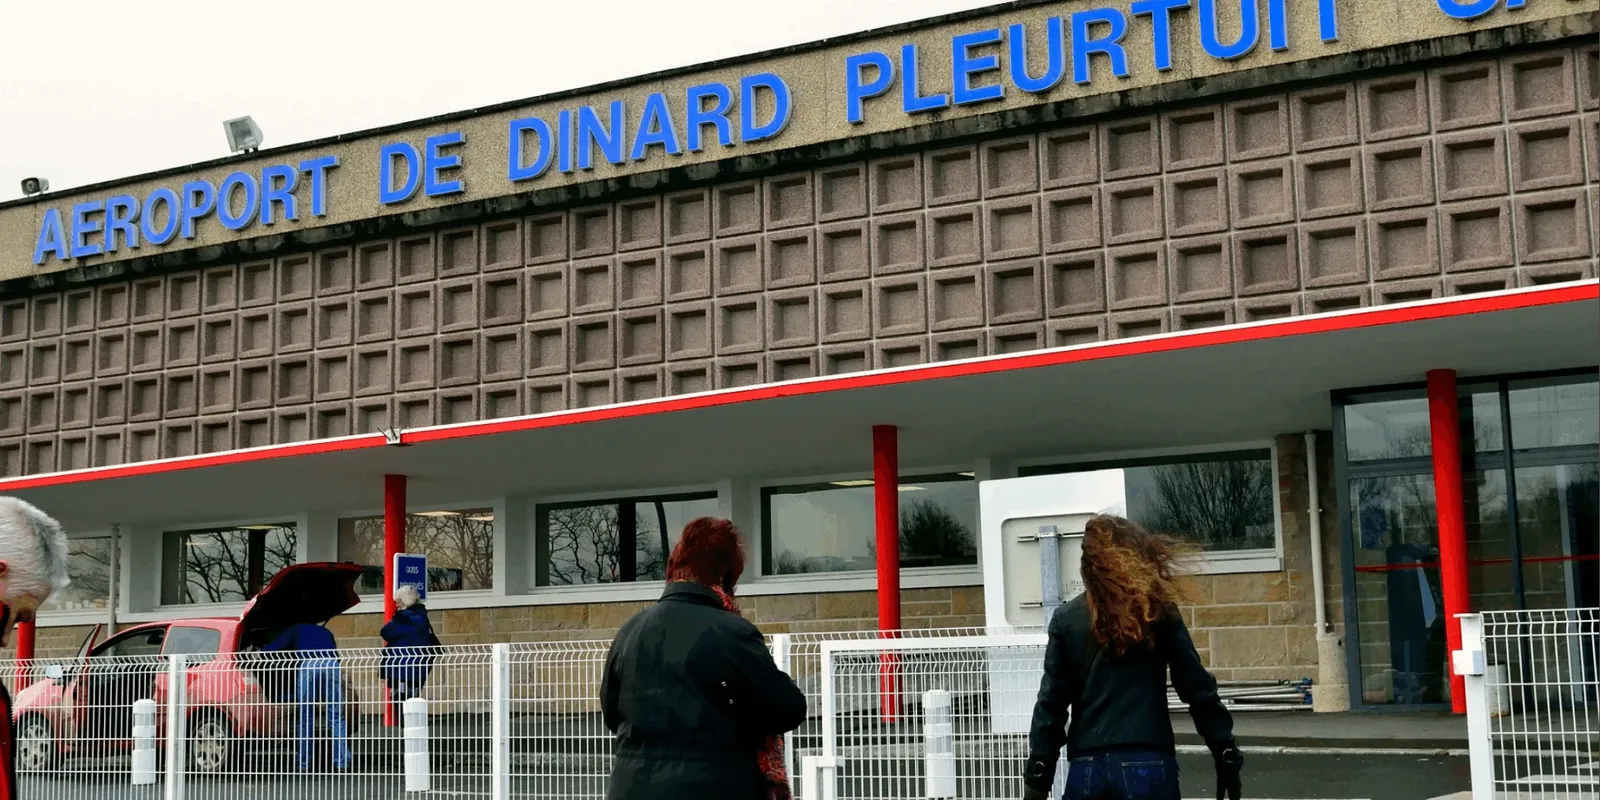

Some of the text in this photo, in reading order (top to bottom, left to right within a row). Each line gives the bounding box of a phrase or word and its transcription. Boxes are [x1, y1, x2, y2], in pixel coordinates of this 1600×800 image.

[34, 155, 339, 264] AEROPORT
[380, 132, 465, 206] DE
[508, 73, 793, 183] DINARD
[405, 566, 419, 574] TAXIS
